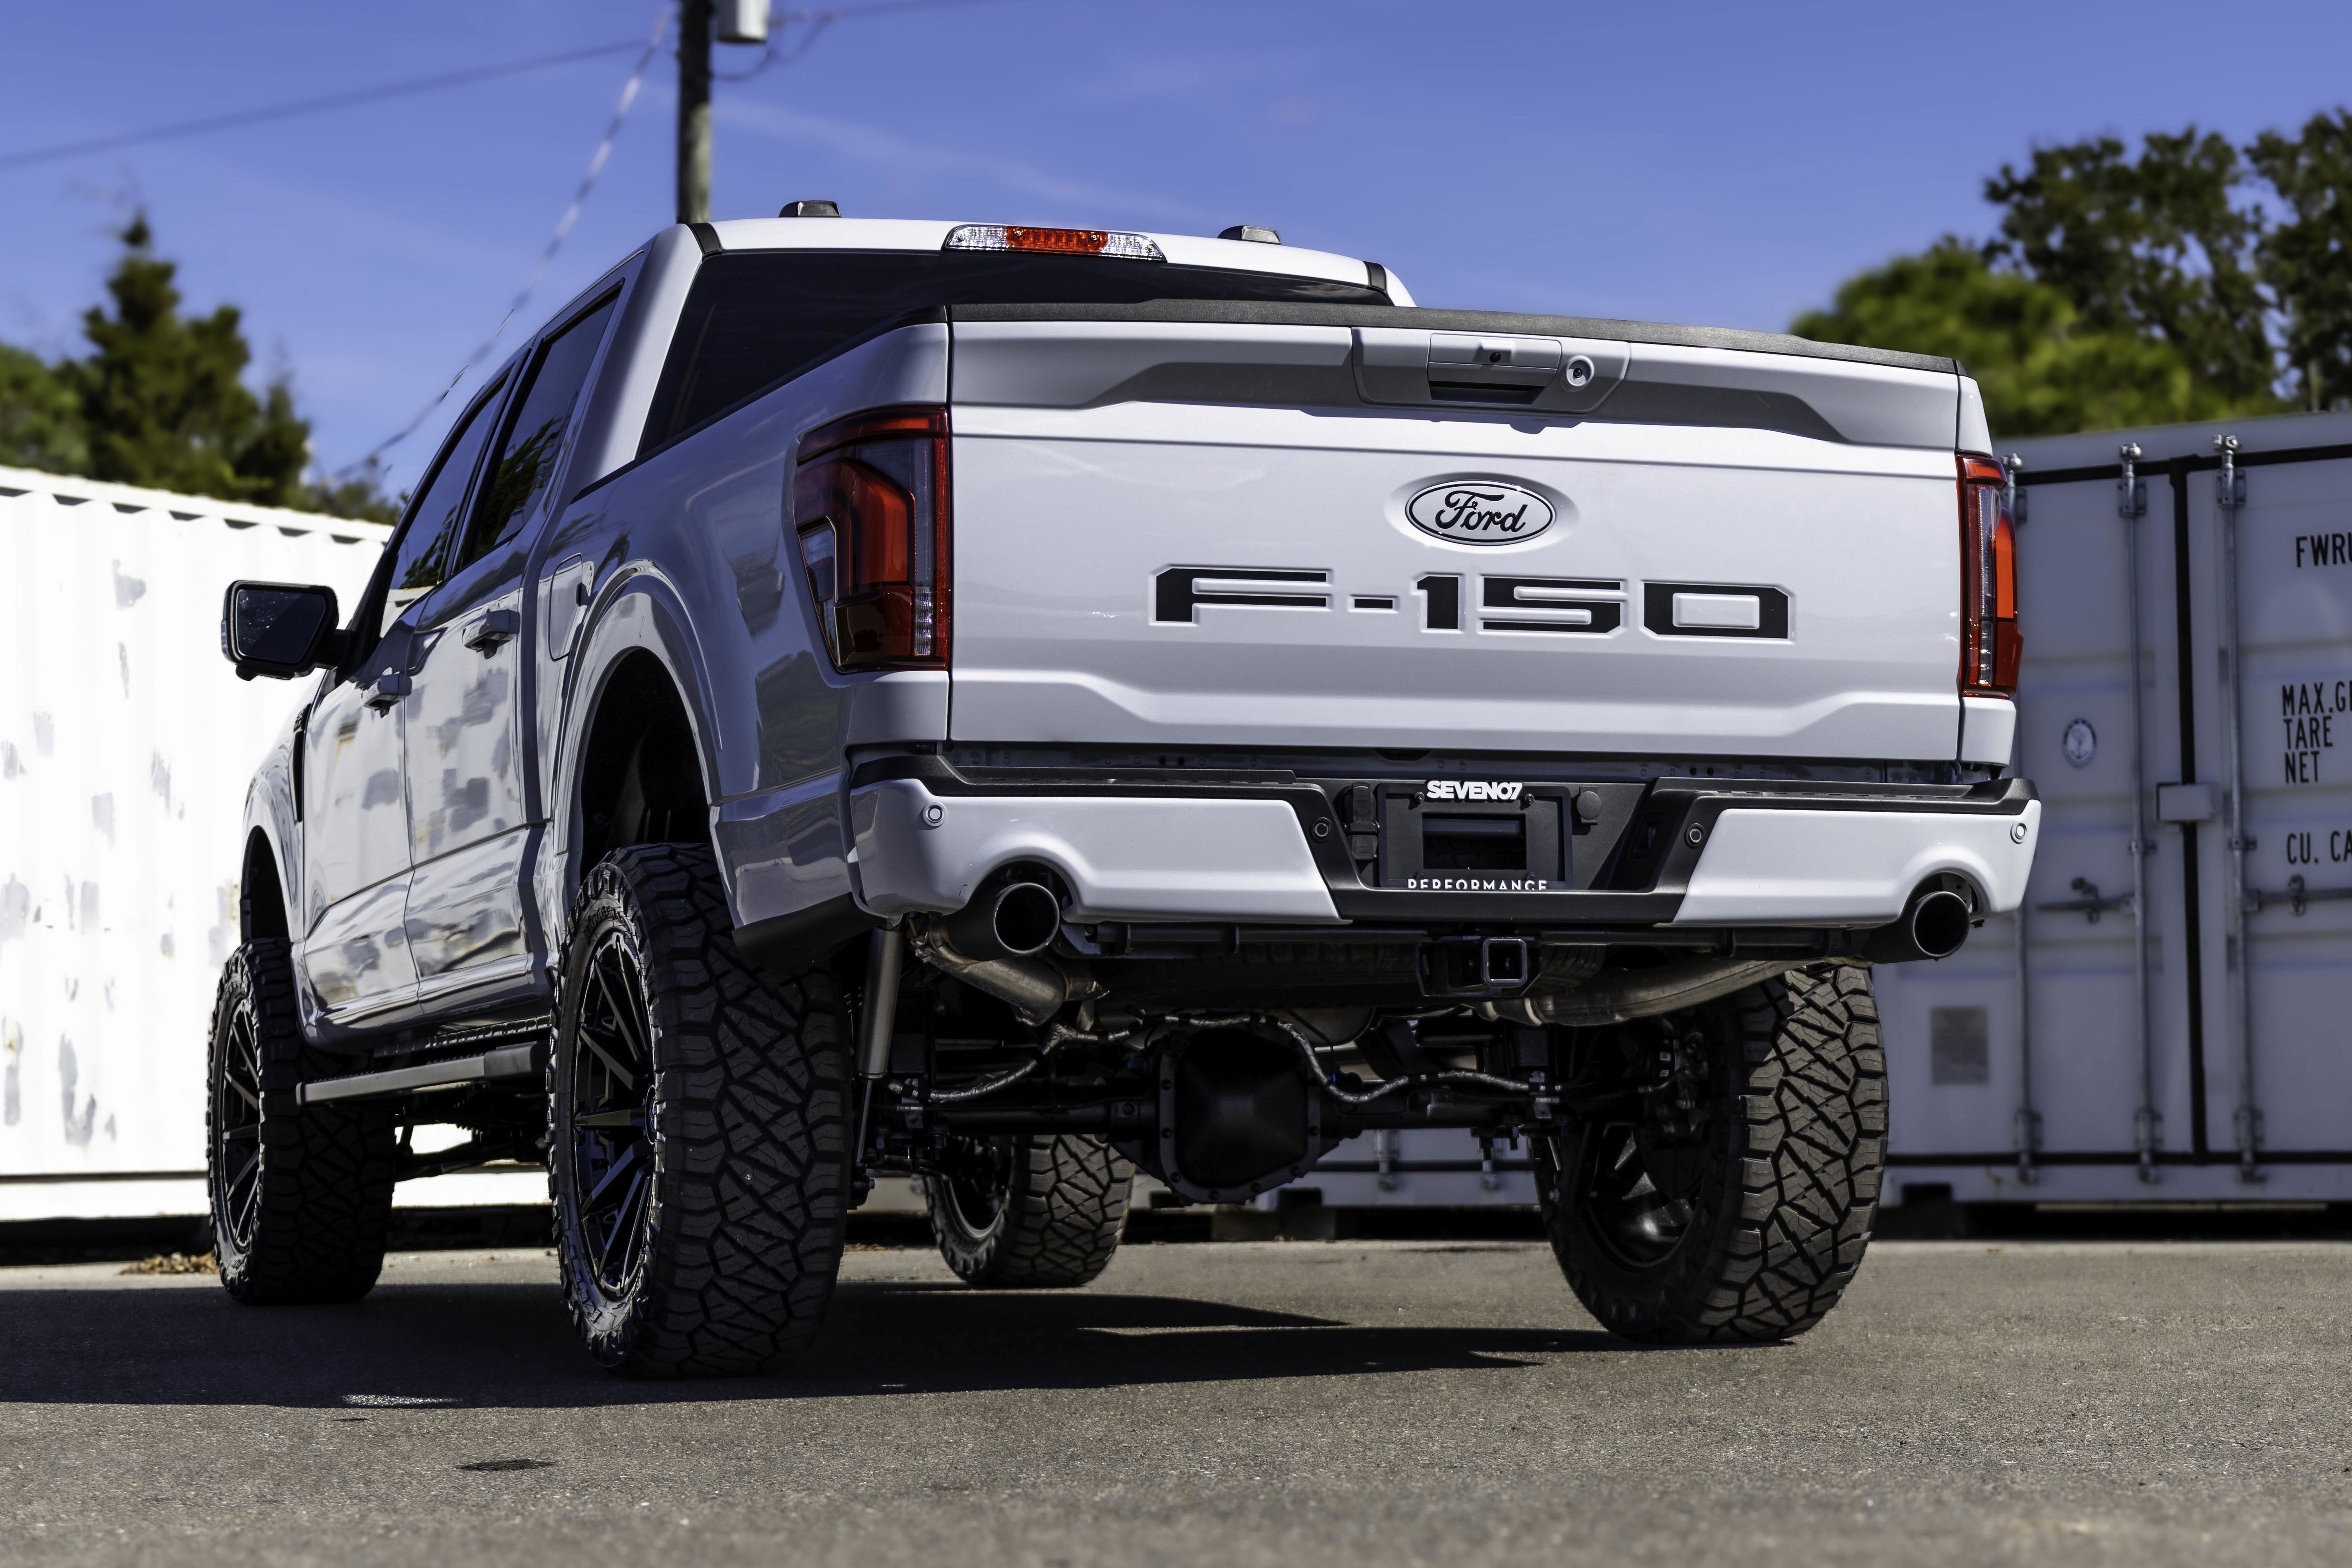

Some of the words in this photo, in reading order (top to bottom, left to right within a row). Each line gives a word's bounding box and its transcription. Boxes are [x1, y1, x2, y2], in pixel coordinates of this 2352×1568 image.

[1435, 490, 1528, 533] Ford
[1154, 566, 1791, 641] F-150
[2282, 679, 2352, 715] MAX.G
[2283, 715, 2333, 749] TARE
[2285, 750, 2320, 784] NET
[2287, 832, 2319, 865] CU.
